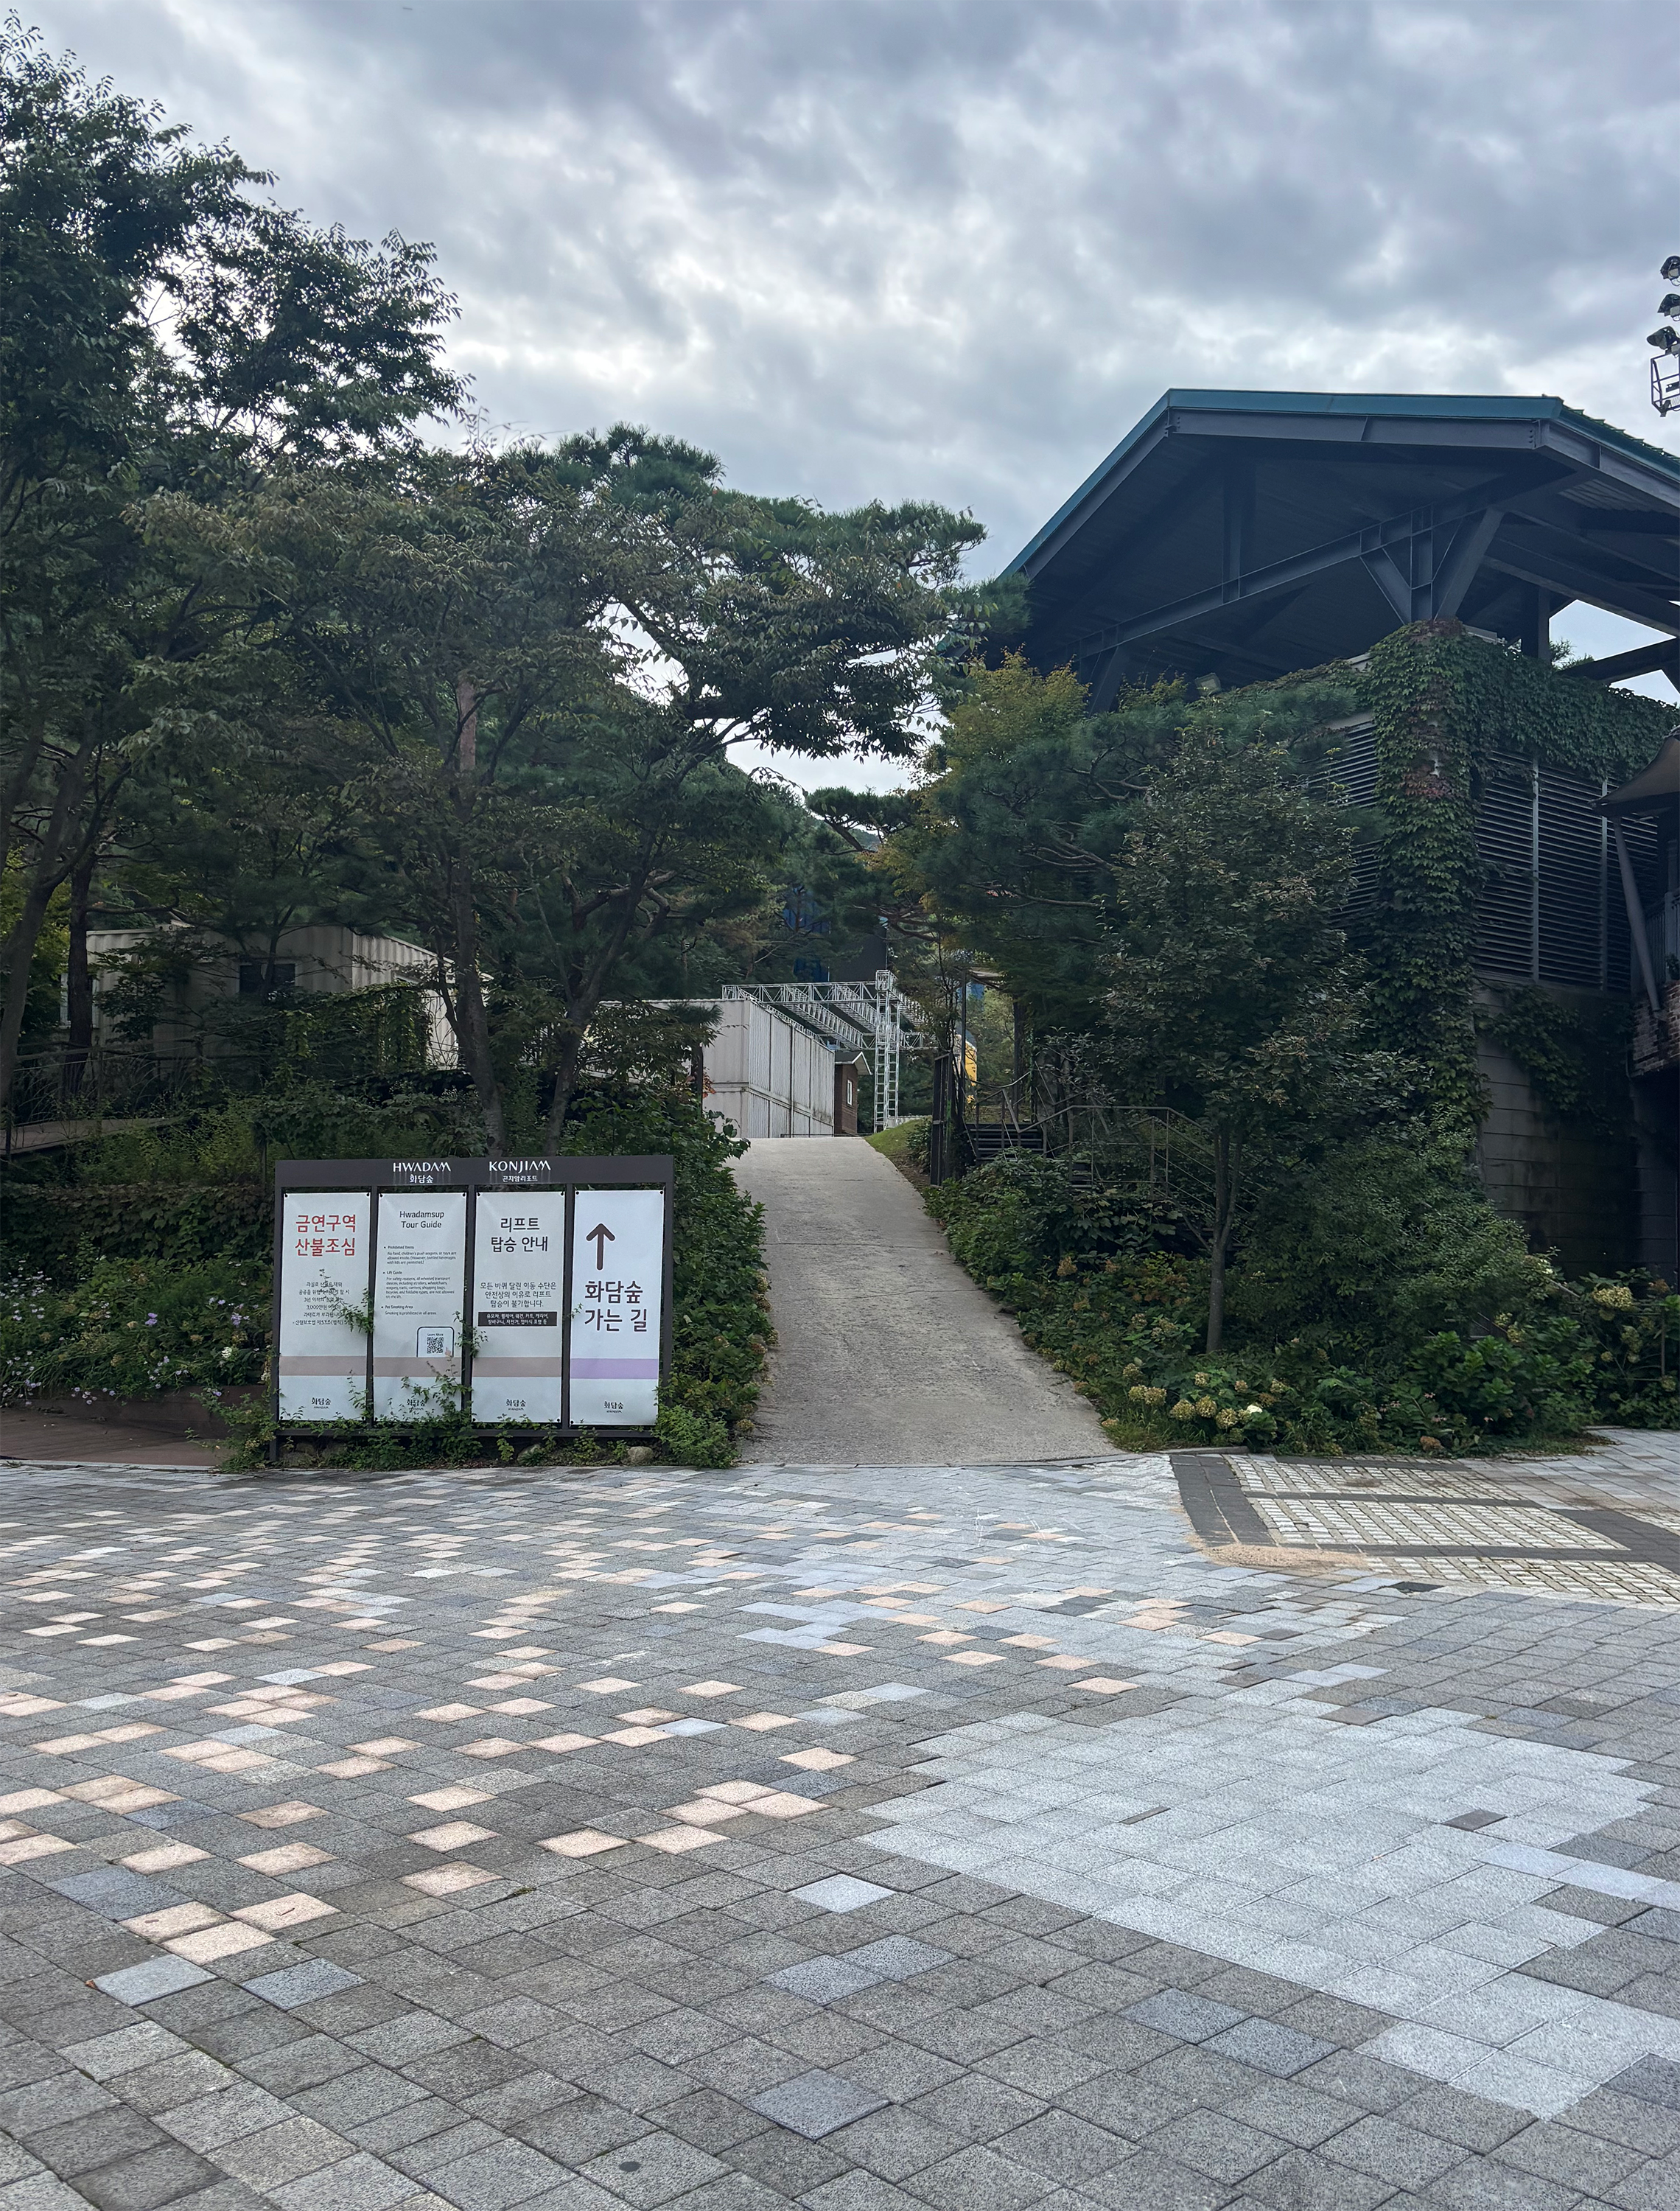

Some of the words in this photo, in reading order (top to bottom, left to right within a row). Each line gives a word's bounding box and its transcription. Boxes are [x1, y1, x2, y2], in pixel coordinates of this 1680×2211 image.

[393, 1162, 452, 1173] HWADAM
[489, 1160, 551, 1173] KONJIAM
[409, 1174, 434, 1184] 화담숲
[399, 1210, 444, 1219] Hwadamsup
[295, 1214, 356, 1233] 금연구역
[402, 1220, 419, 1229] Tour
[421, 1220, 442, 1229] Guide
[500, 1218, 540, 1232] 리프트
[295, 1237, 355, 1257] 산불조심
[491, 1237, 517, 1252] 탑승
[522, 1236, 547, 1251] 안내
[584, 1280, 643, 1304] 화담숲
[584, 1308, 623, 1332] 가는
[630, 1308, 647, 1332] 길
[312, 1397, 331, 1405] 화담숲
[506, 1399, 526, 1407] 화담숲
[604, 1401, 624, 1409] 화담숲
